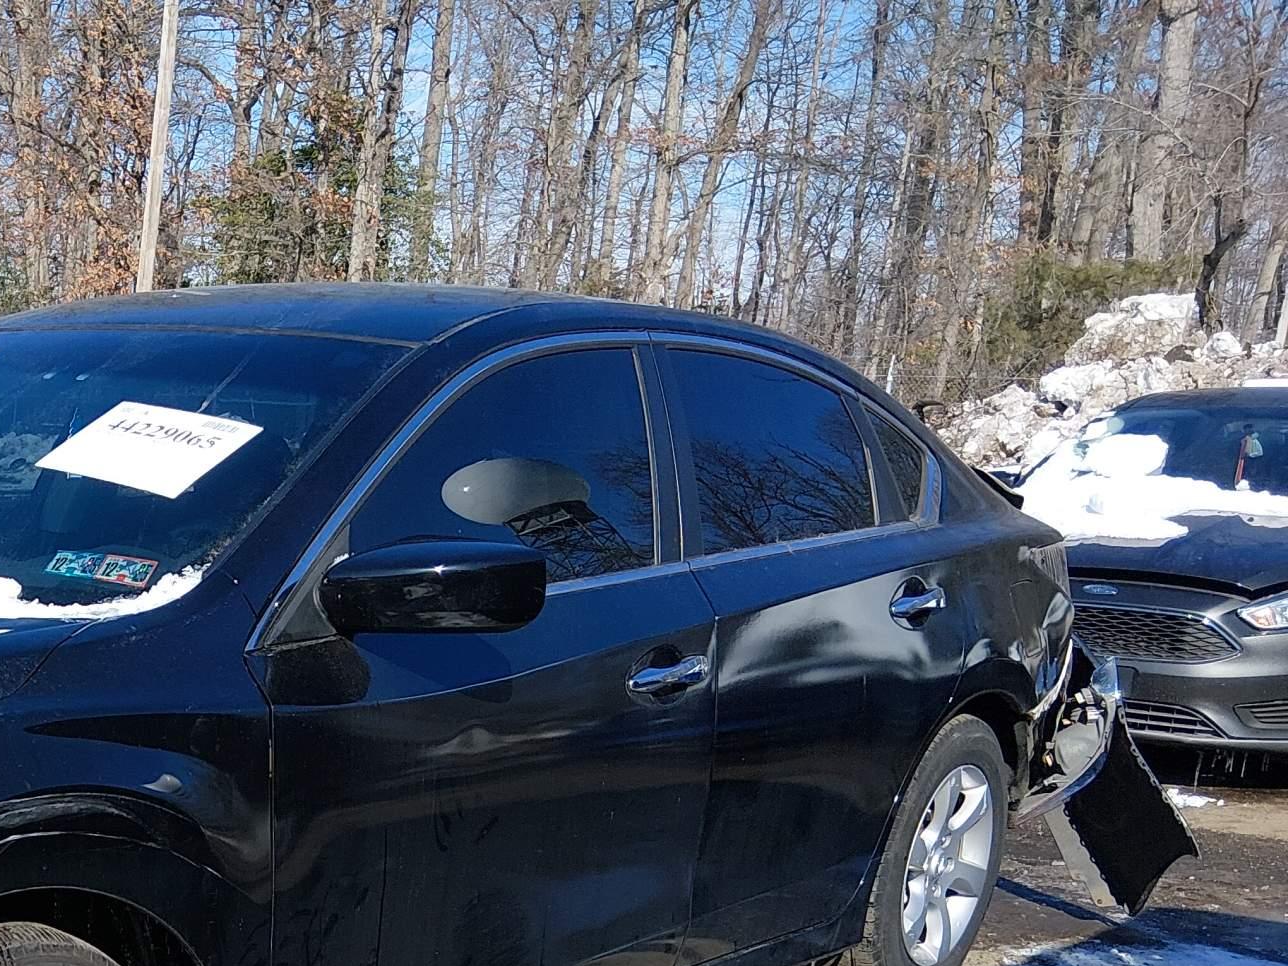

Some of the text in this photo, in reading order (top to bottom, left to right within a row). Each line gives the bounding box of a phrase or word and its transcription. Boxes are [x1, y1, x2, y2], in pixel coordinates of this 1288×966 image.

[107, 418, 223, 449] 44229065
[51, 557, 68, 571] 12
[101, 562, 119, 577] 12
